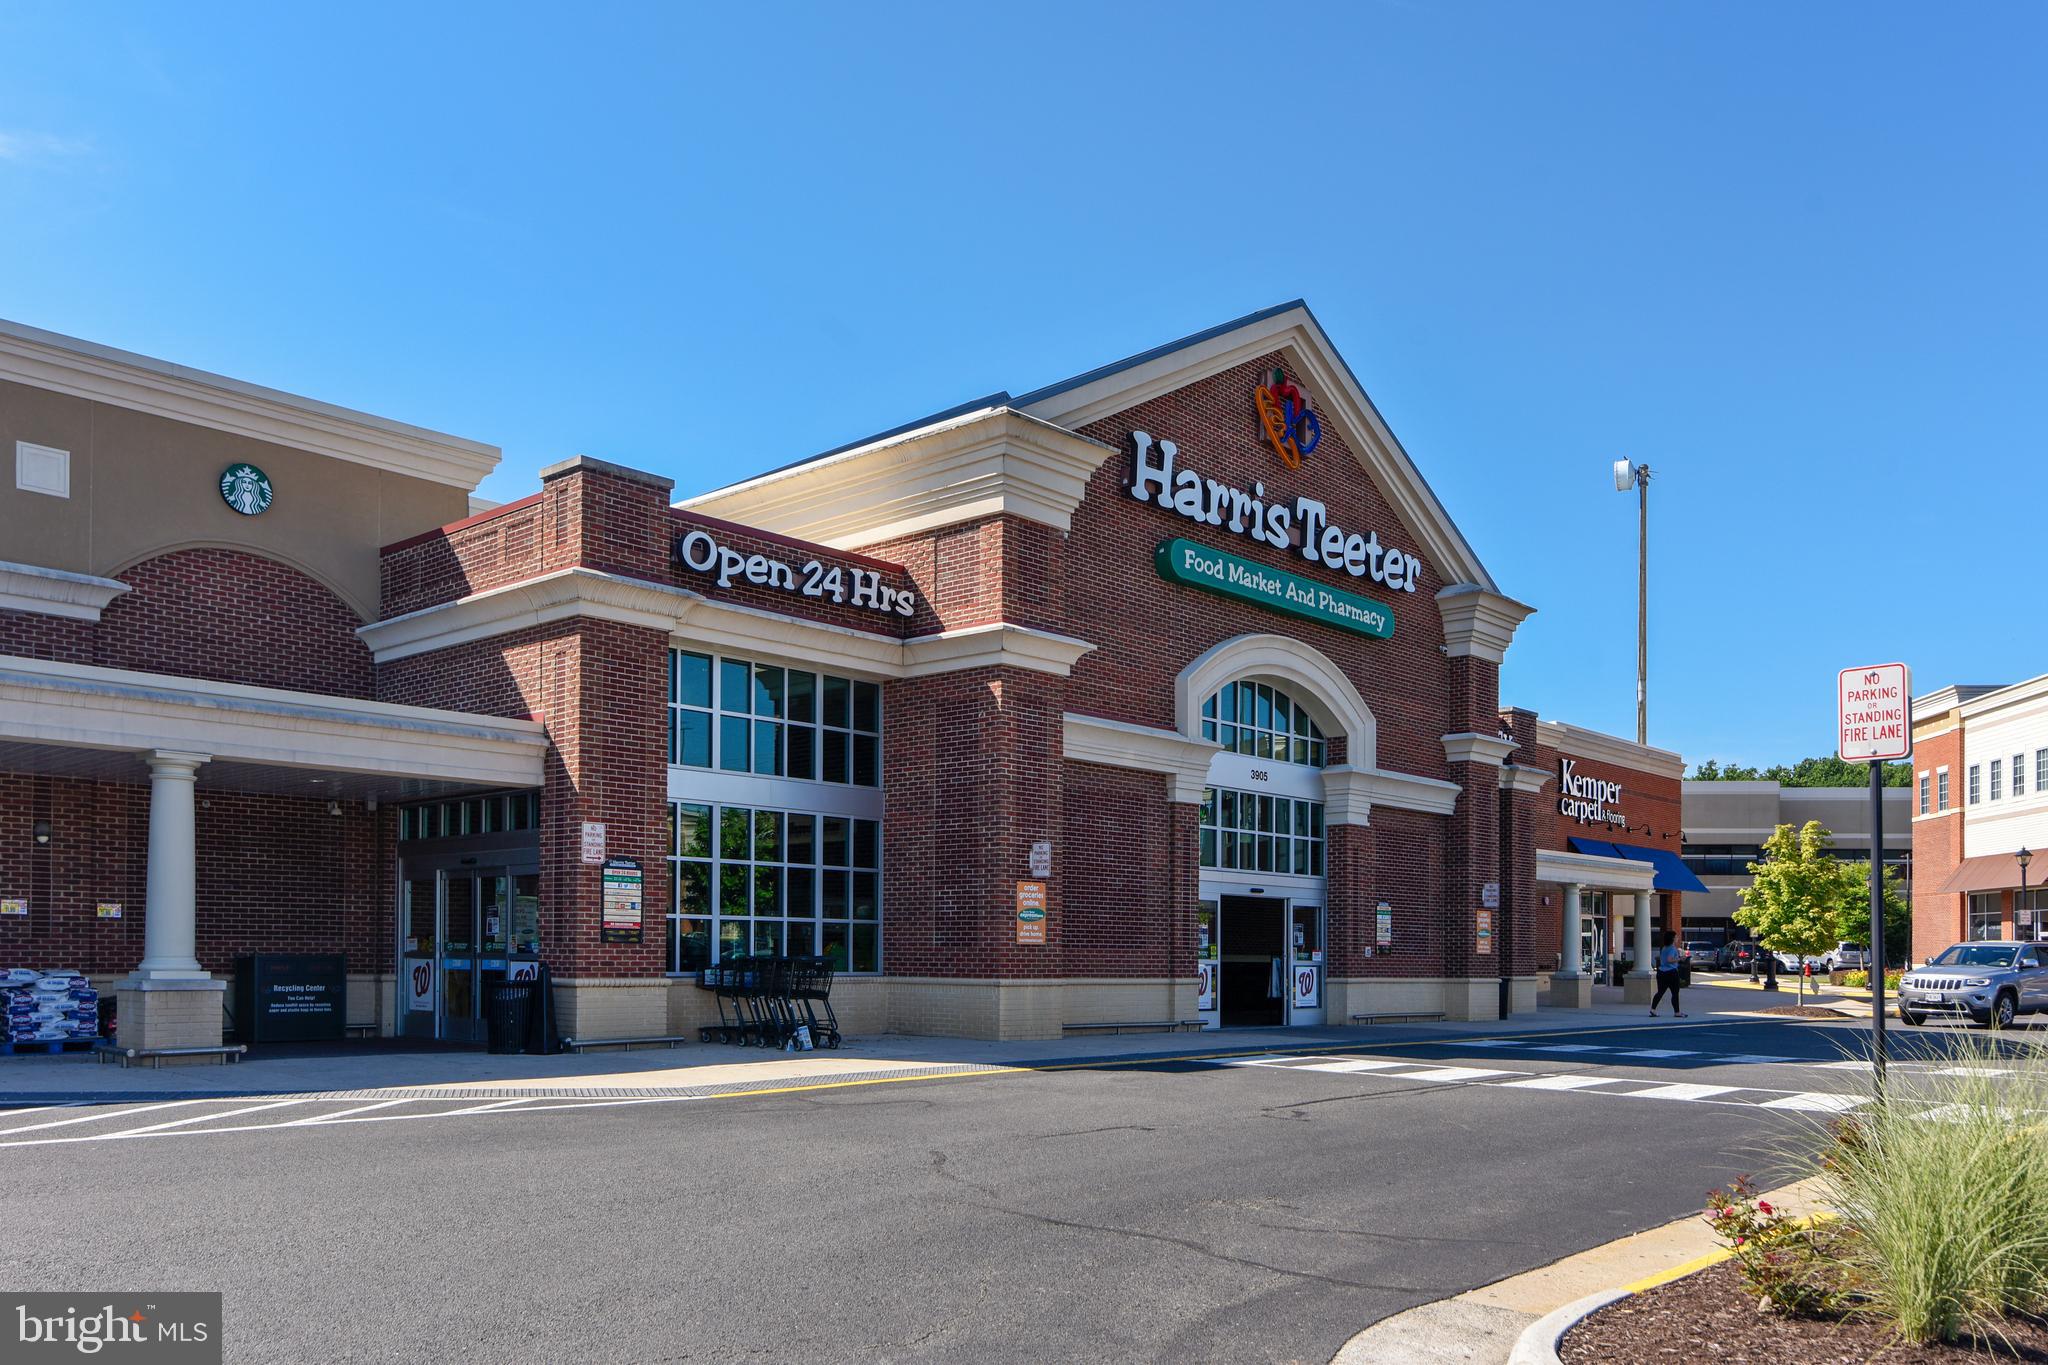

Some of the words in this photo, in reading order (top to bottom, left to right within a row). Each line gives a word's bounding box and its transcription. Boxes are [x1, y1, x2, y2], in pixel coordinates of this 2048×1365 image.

[1131, 430, 1290, 549] Harris
[1297, 496, 1421, 593] Teeter
[682, 531, 795, 590] Open
[802, 561, 844, 603] 24
[850, 568, 915, 617] Hrs
[1184, 549, 1225, 580] Food
[1228, 563, 1282, 597] Market
[1286, 581, 1317, 608] And
[1319, 591, 1386, 633] Pharmacy
[1864, 673, 1880, 685] NO
[1847, 687, 1897, 702] PARKING
[1844, 708, 1902, 725] STANDING
[1844, 726, 1868, 742] FIRE
[1872, 723, 1903, 740] LANE
[1250, 769, 1268, 782] 3905
[1561, 758, 1622, 820] Kemper
[1606, 809, 1626, 828] flooring
[273, 984, 304, 993] Recycling
[305, 984, 326, 992] Center
